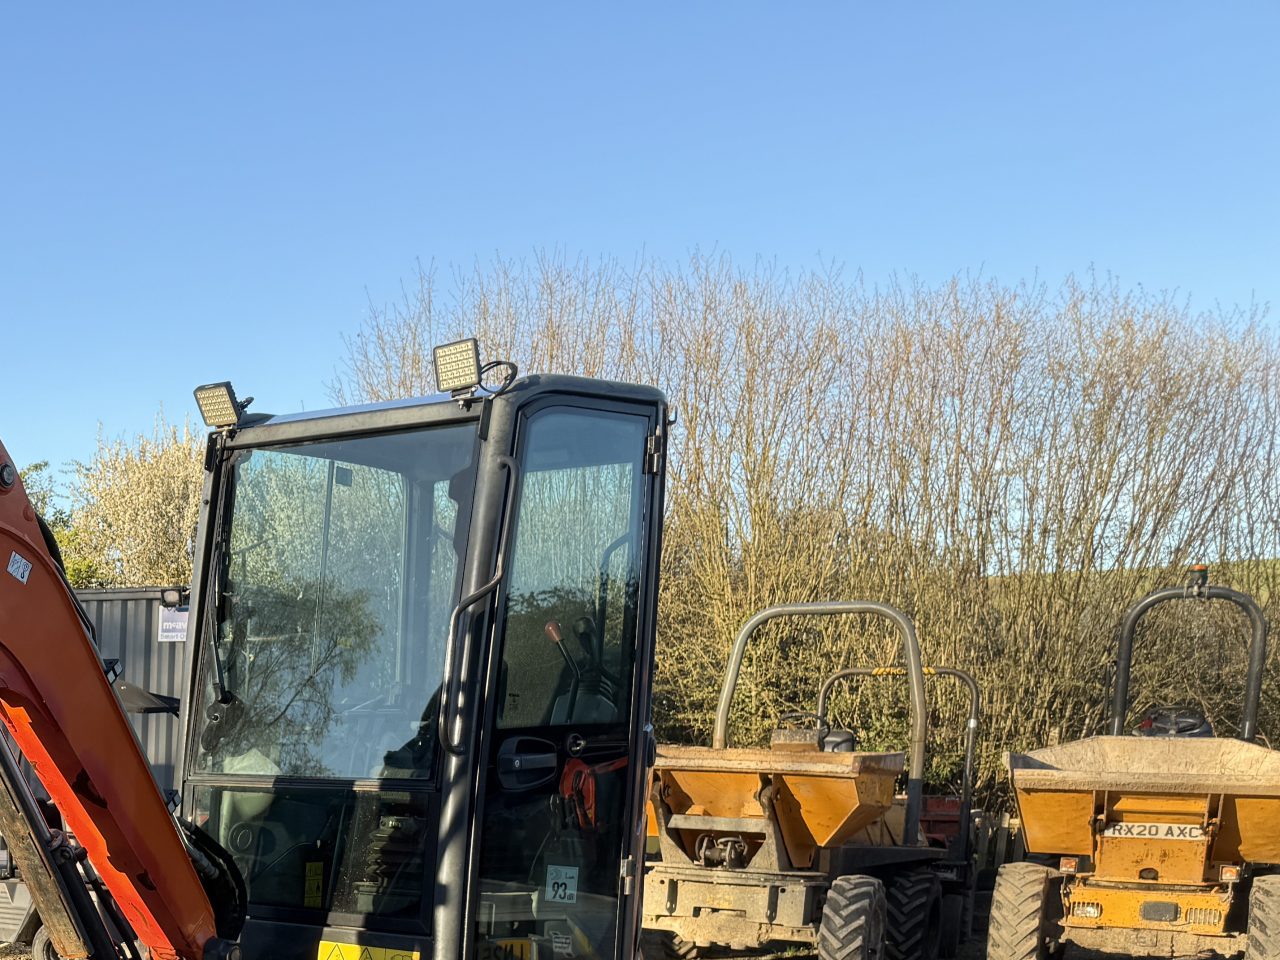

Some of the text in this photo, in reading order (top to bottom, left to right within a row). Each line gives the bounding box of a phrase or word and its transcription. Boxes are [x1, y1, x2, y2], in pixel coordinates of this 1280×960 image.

[1112, 824, 1200, 838] RX20 AXC
[551, 881, 568, 900] 93
